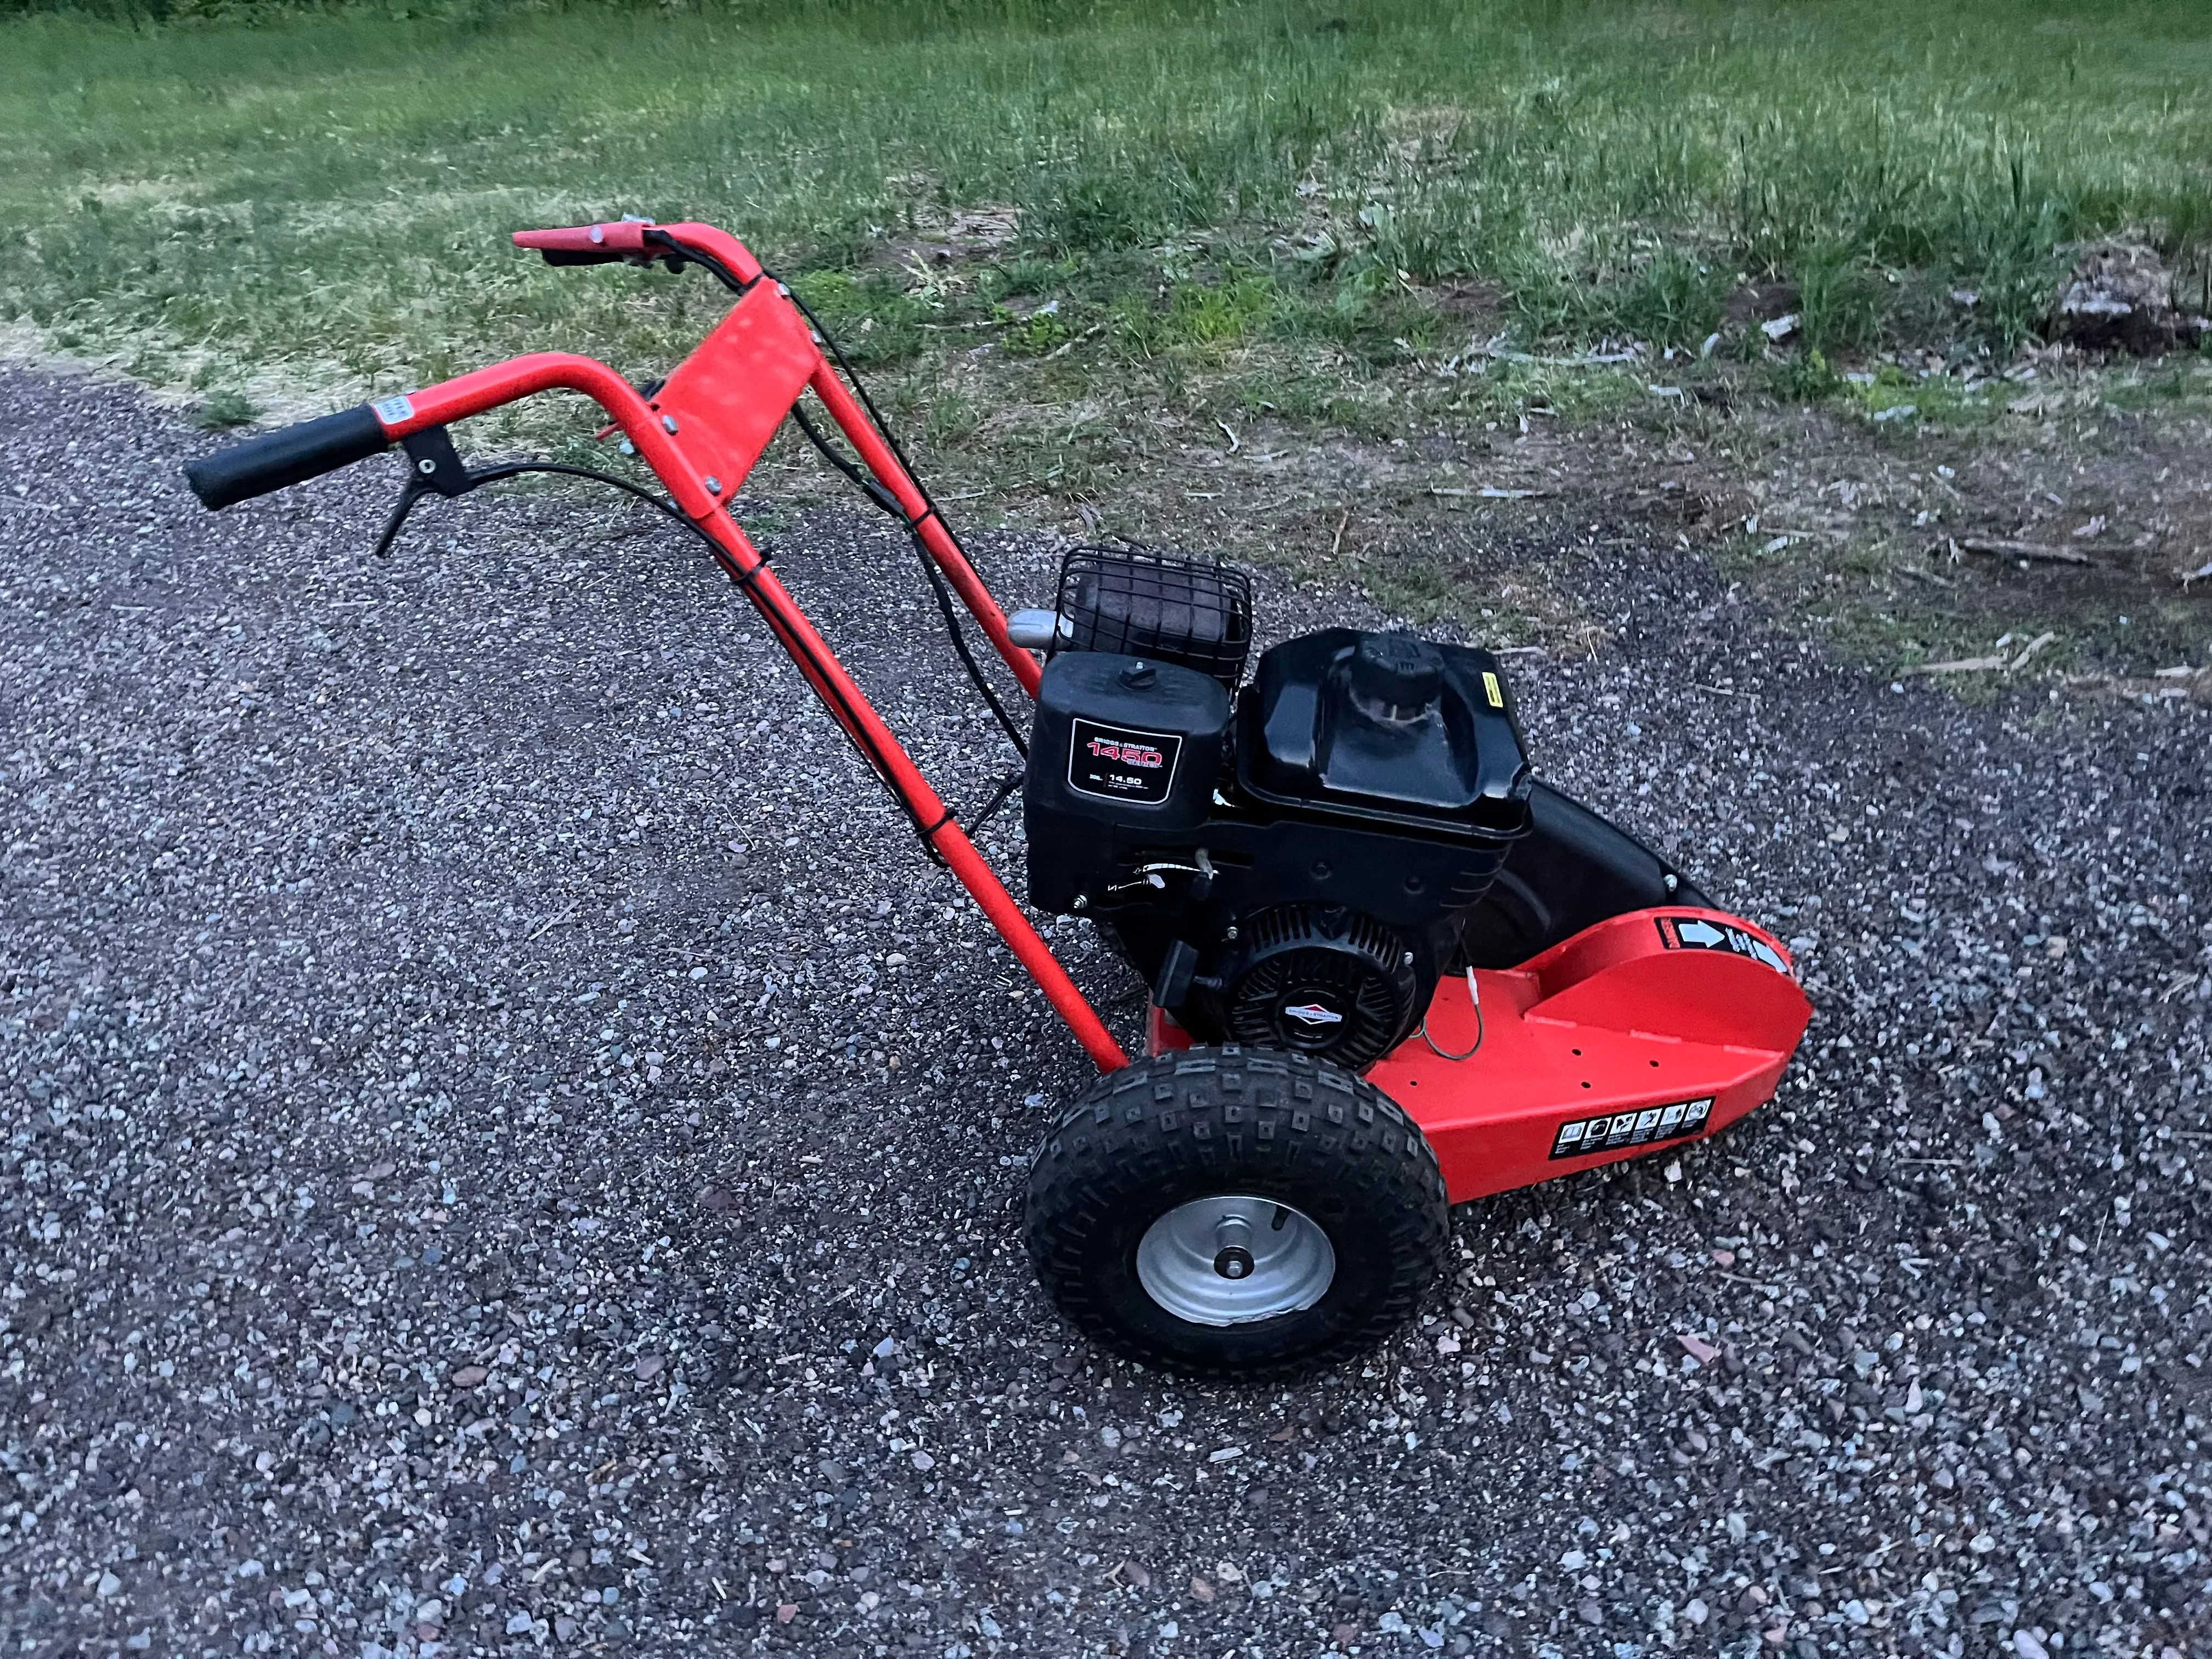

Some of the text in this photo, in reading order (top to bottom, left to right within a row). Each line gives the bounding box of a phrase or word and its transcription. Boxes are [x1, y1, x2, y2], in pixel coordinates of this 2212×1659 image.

[1094, 737, 1119, 746] BRIGGS
[1087, 742, 1162, 765] 1450
[1110, 774, 1142, 785] 14.50
